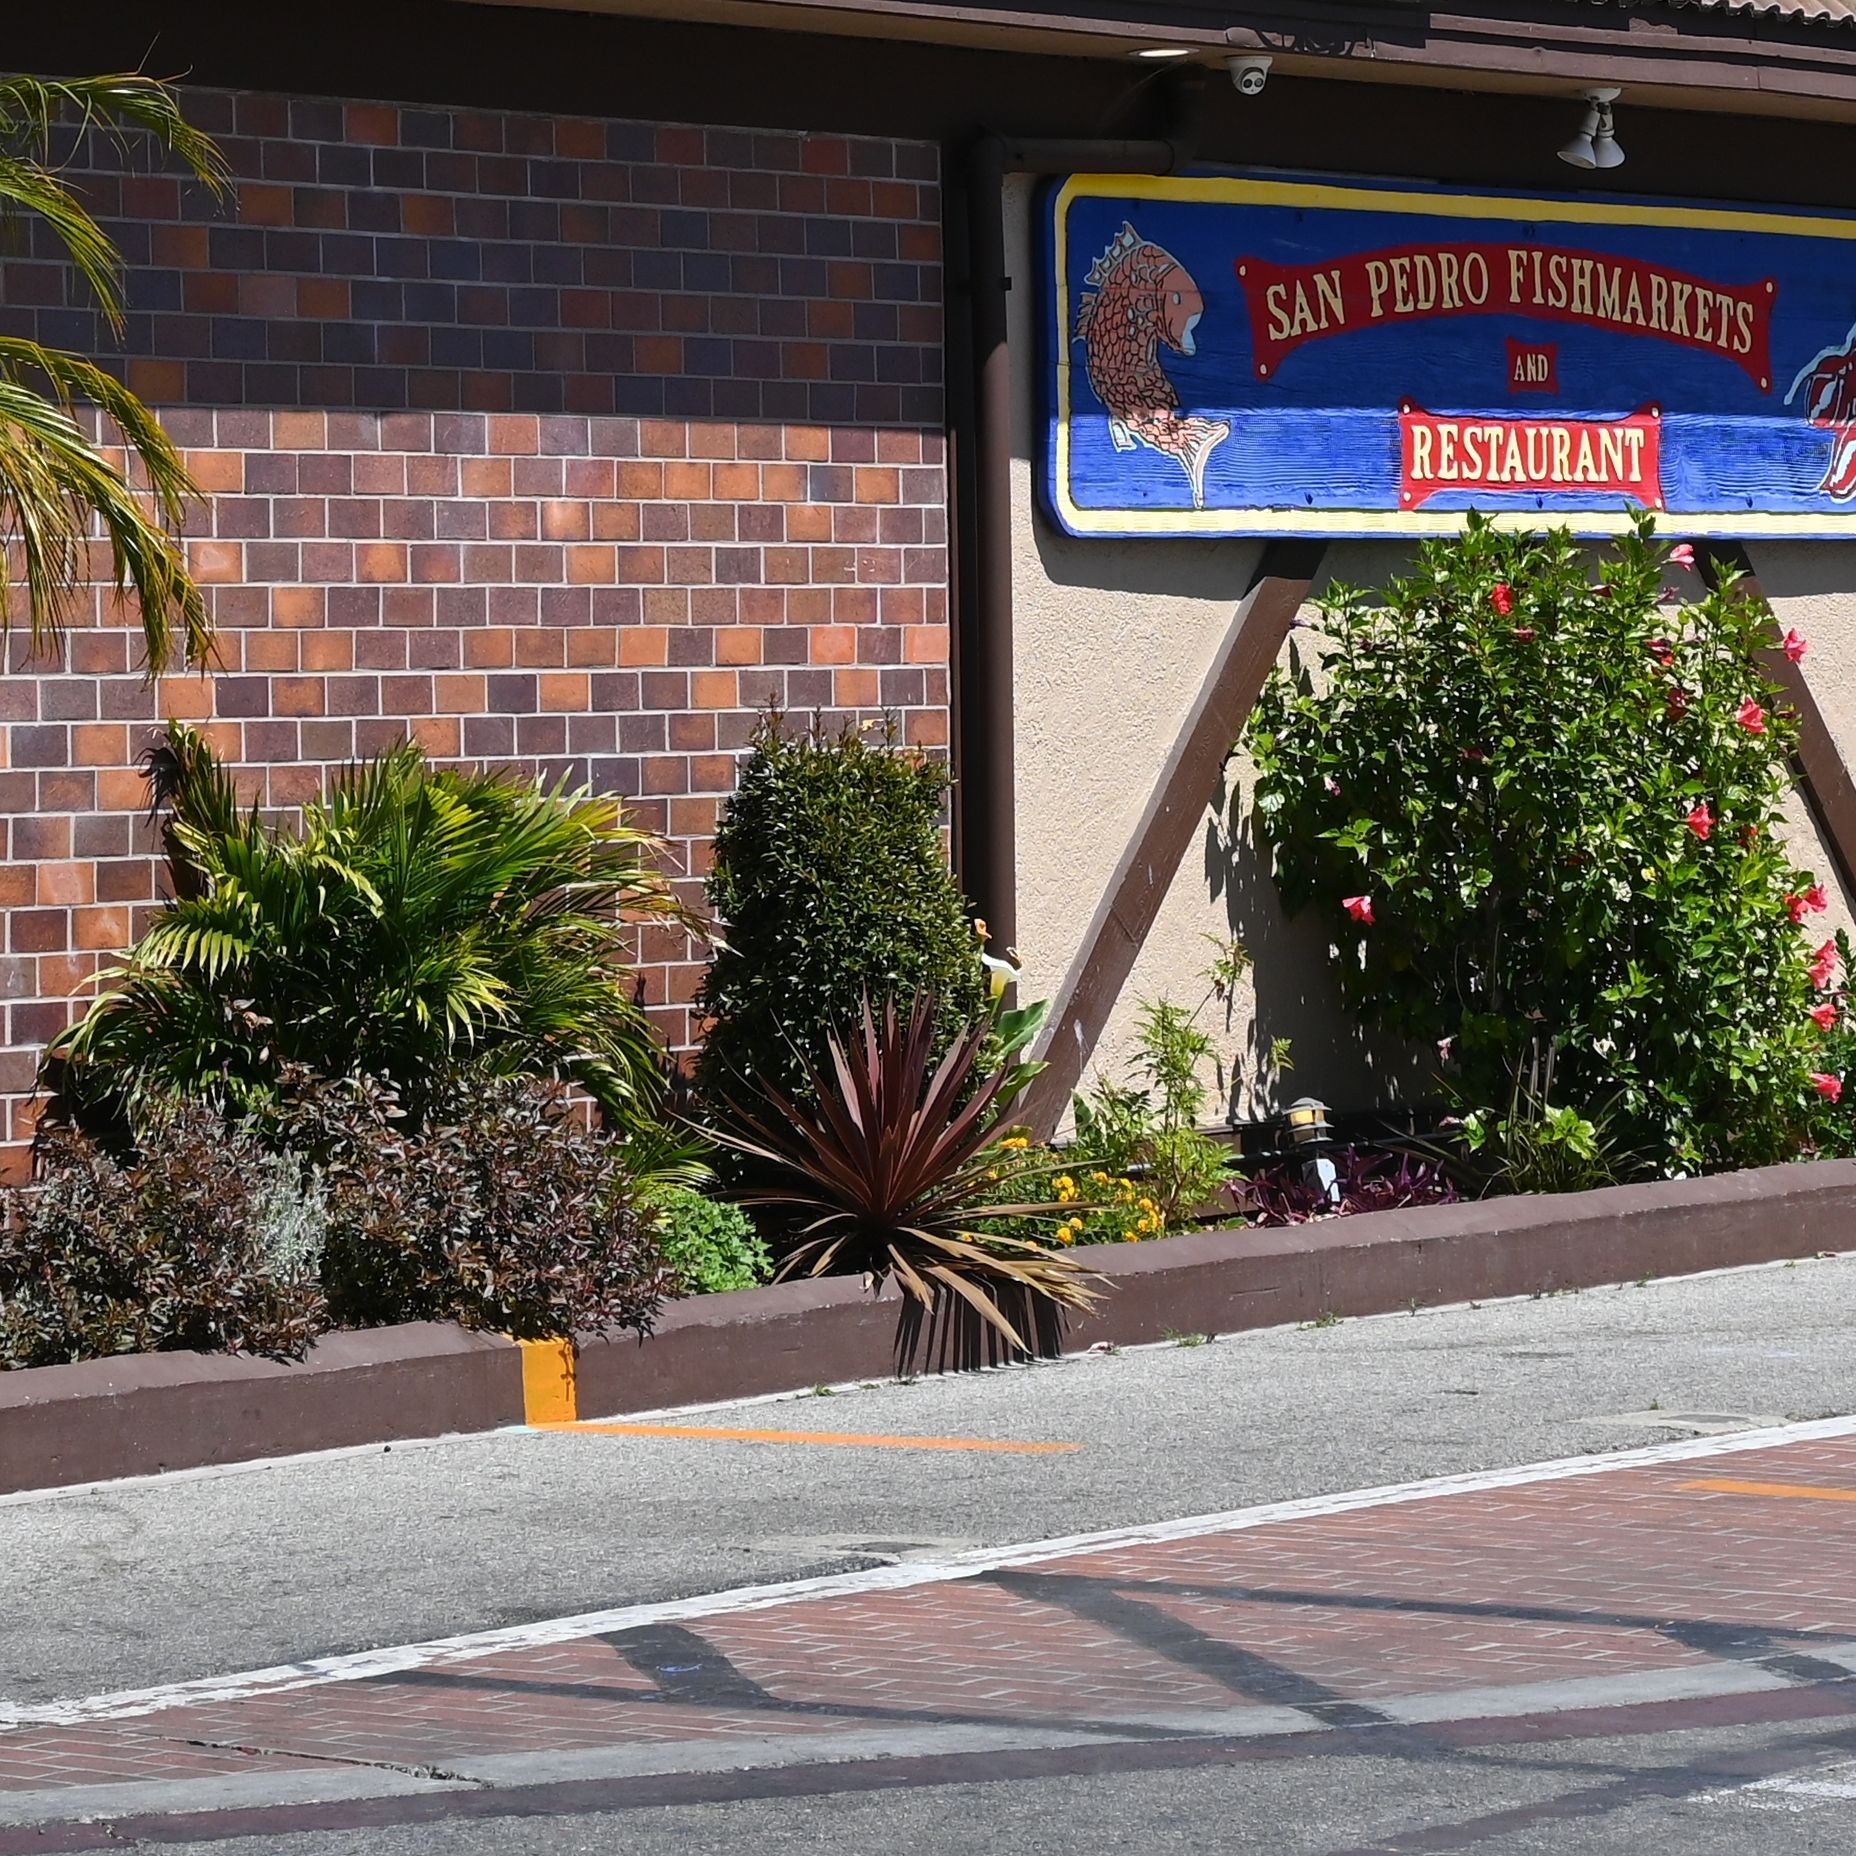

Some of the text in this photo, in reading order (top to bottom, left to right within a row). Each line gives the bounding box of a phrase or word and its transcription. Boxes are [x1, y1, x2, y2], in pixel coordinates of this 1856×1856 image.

[1265, 248, 1754, 355] SAN PEDRO FISHMARKETS
[1513, 352, 1549, 382] AND
[1410, 423, 1645, 483] RESTAURANT
